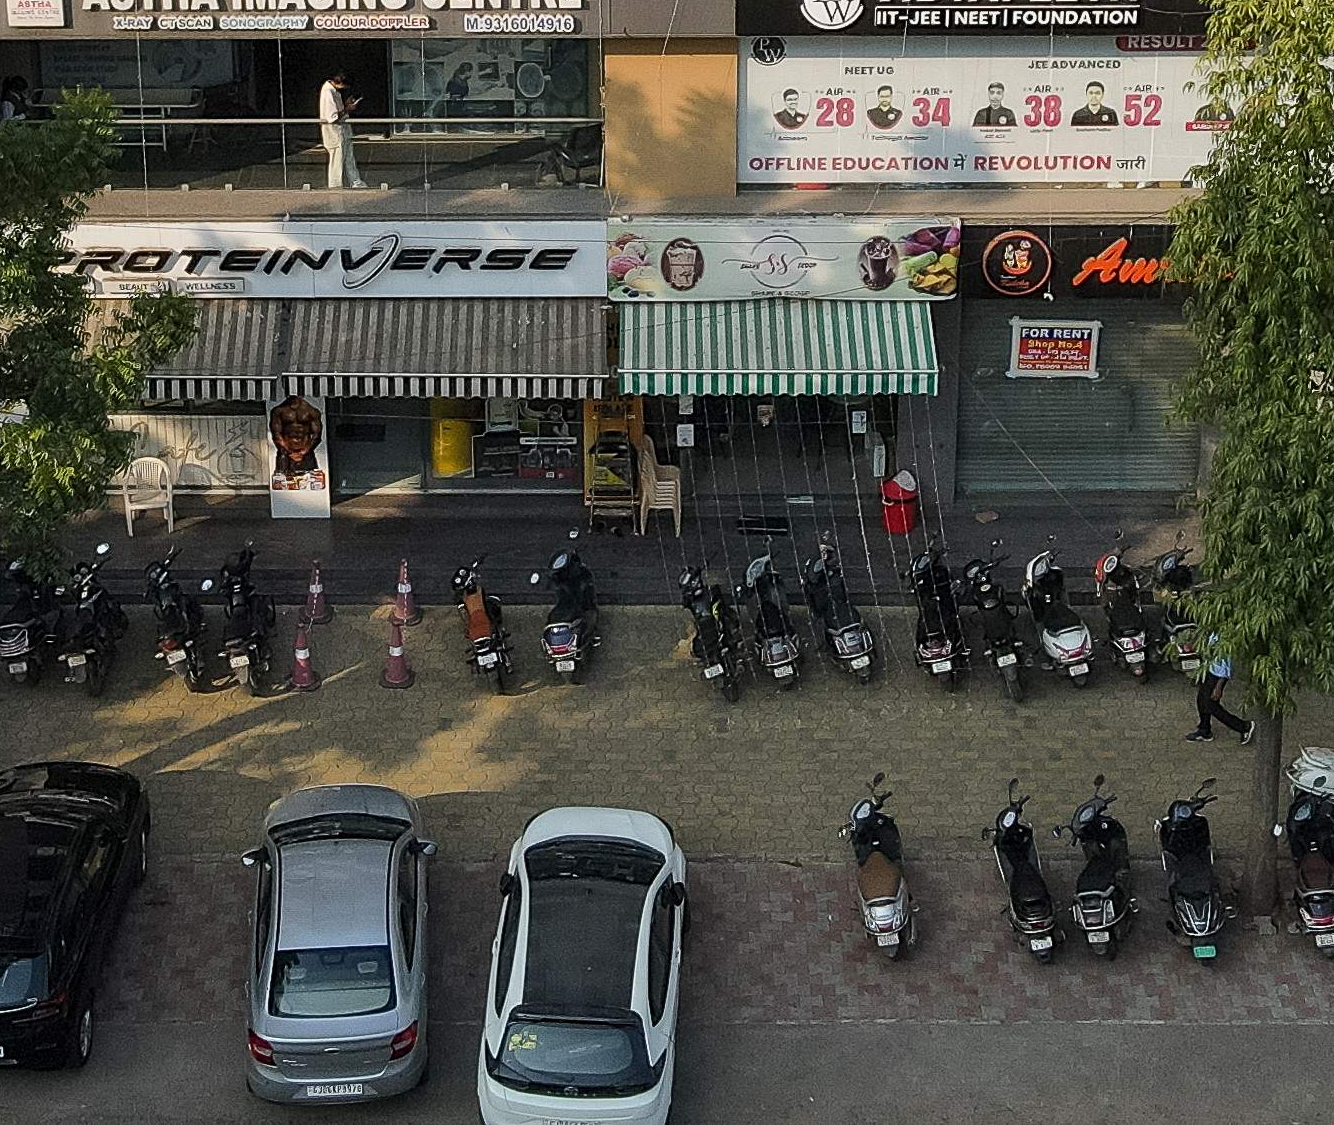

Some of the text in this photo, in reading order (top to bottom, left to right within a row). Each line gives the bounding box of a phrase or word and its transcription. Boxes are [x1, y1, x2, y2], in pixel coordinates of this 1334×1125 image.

[115, 18, 152, 27] X-RAY
[222, 18, 307, 27] SONOGRAPHY
[315, 18, 367, 27] COLOUR
[370, 18, 428, 27] DOPPLER
[876, 10, 1138, 25] IIT-JEE NEET FOUNDATION
[1127, 35, 1195, 48] RESULT
[845, 66, 894, 75] NEET UG
[1028, 60, 1121, 69] JEE ADVANCED
[1034, 85, 1052, 93] AIR
[816, 97, 855, 127] 28
[912, 97, 951, 127] 34
[1024, 94, 1062, 127] 38
[1123, 94, 1162, 127] 52
[749, 156, 828, 171] OFFLINE
[832, 156, 949, 171] EDUCATION
[974, 155, 1112, 171] REVOLUTION
[1022, 328, 1091, 339] FOR RENT
[1028, 339, 1054, 348] Shop
